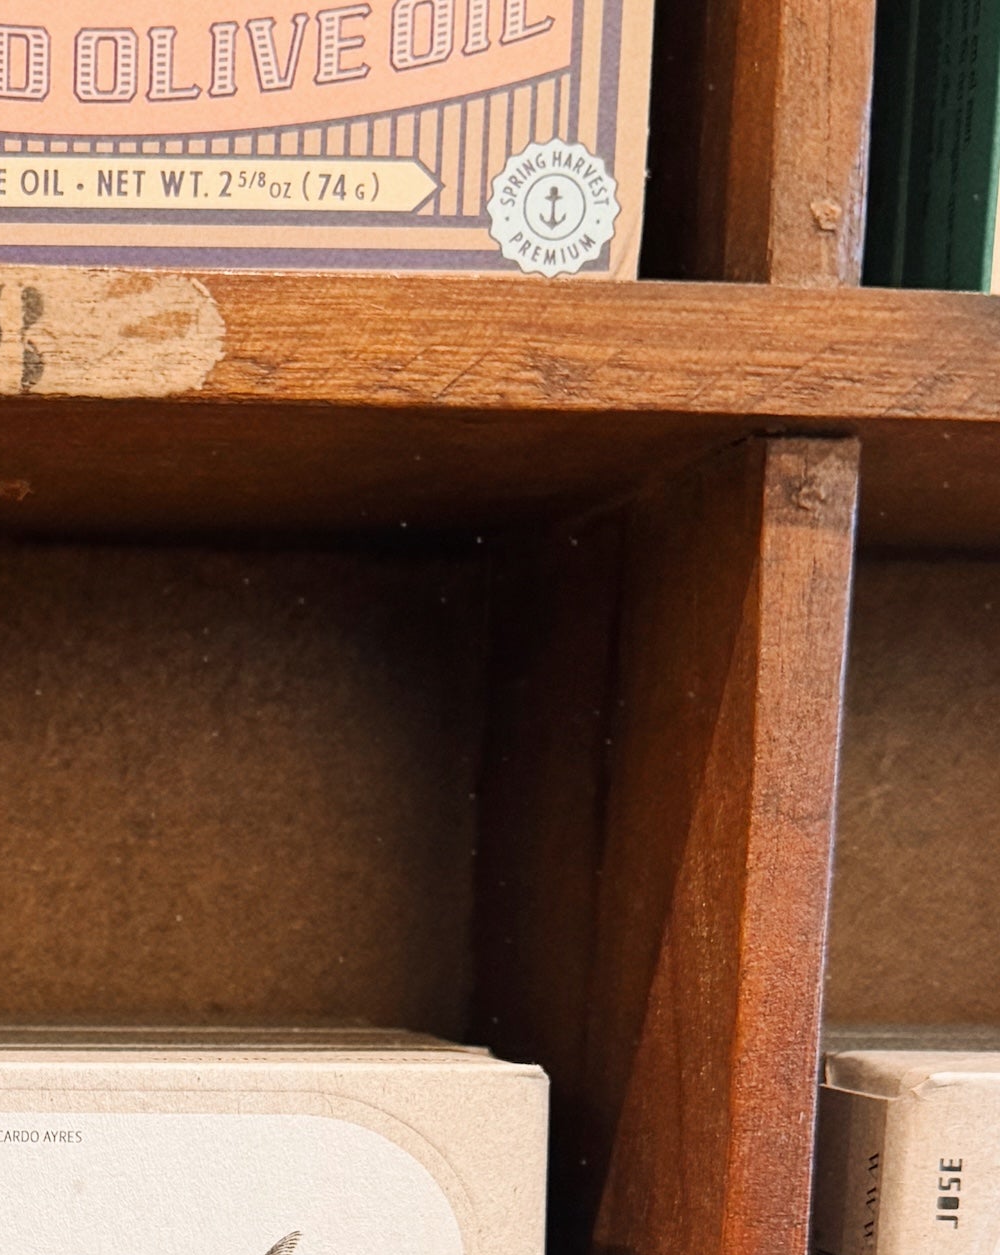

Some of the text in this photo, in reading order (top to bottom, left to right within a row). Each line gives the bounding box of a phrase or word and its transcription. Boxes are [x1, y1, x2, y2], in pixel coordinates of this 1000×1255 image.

[72, 3, 373, 103] OLIVE
[390, 0, 556, 72] OIL
[20, 169, 64, 197] OIL
[97, 170, 146, 197] NET
[160, 170, 209, 198] WT.
[500, 151, 610, 208] SPRING HARVEST
[509, 231, 596, 266] PREMIUM
[43, 1130, 83, 1143] AYRES
[936, 1158, 963, 1230] JOSE
